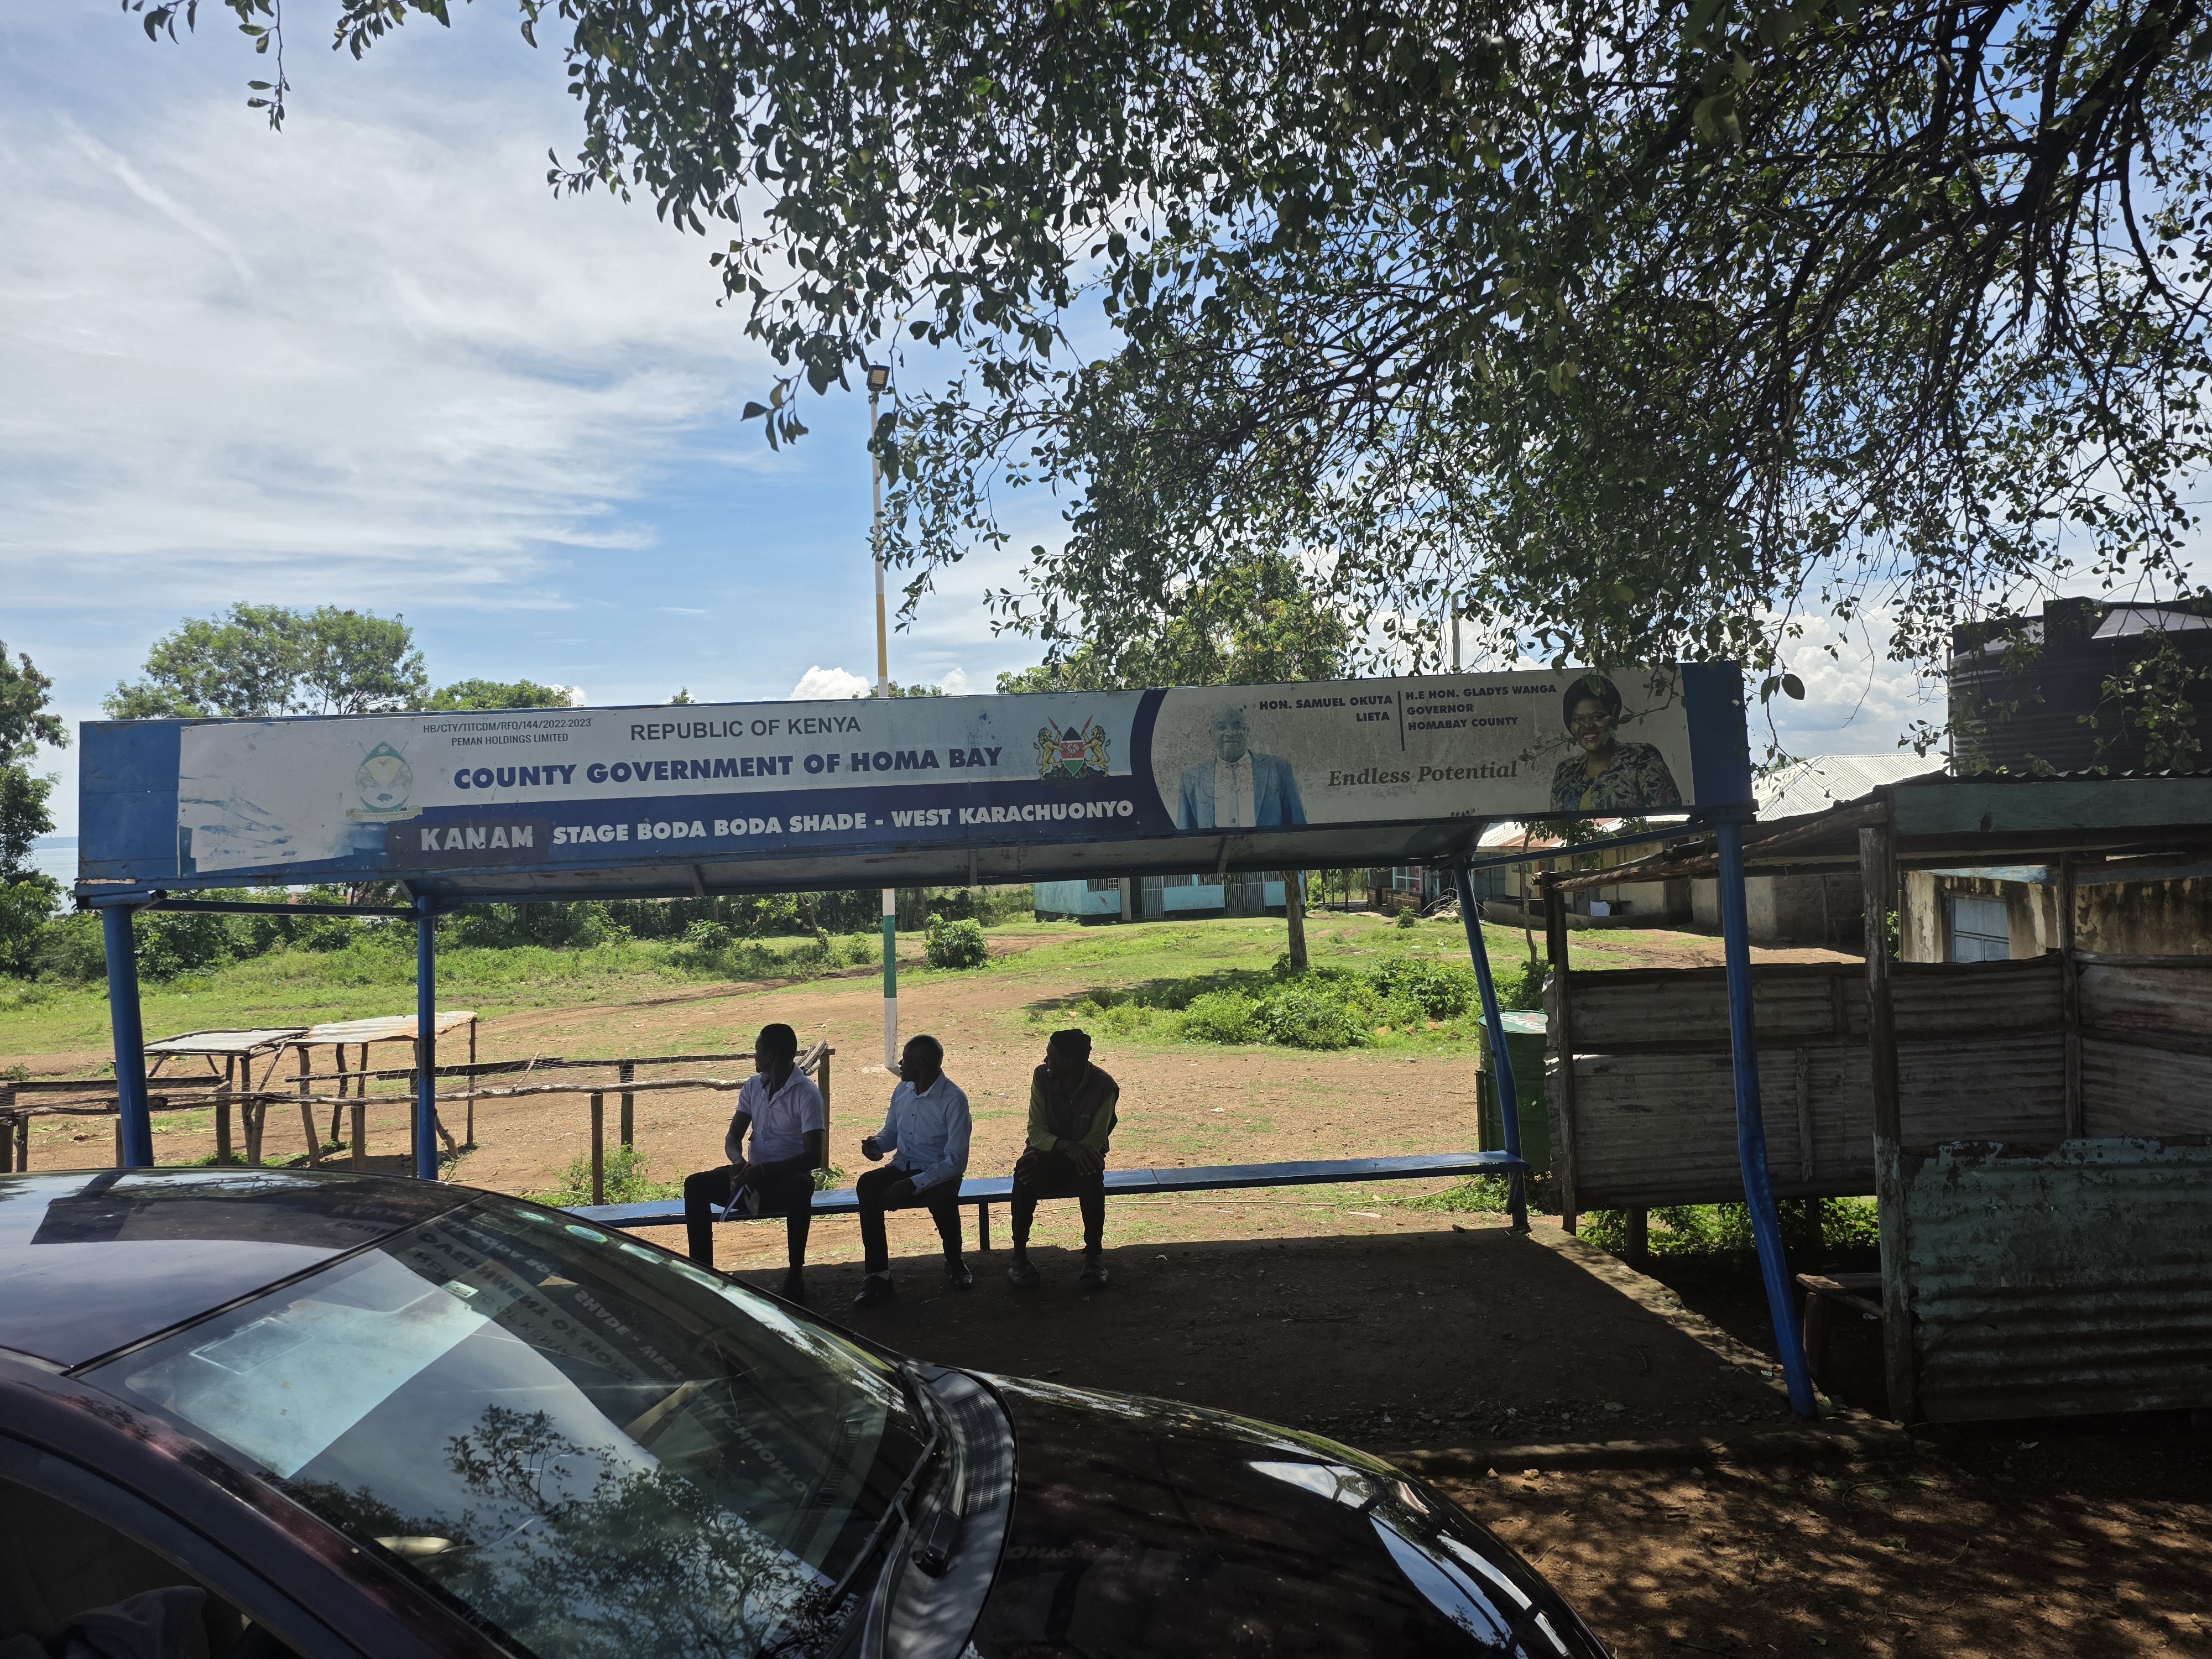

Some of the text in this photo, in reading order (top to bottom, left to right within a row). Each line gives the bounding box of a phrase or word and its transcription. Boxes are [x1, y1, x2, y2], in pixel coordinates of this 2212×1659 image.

[1406, 685, 1557, 700] H.E HON. GLADYS WANGA
[1260, 695, 1392, 710] HON. SAMUEL OKUTA
[1407, 704, 1474, 715] GOVERNOR
[1357, 712, 1390, 722] LIETA
[1408, 717, 1518, 730] HOMABAY COUNTY
[423, 718, 592, 733] HB/CTY/TITCDM/RFQ/144/2022-2023
[631, 717, 861, 740] REPUBLIC OF KENYA
[452, 733, 568, 746] PEMAN HOLDINGS LIMITED
[455, 747, 1003, 789] COUNTY GOVERNMENT OF HOMA BAY
[1328, 760, 1518, 786] Endless Potential
[421, 826, 533, 851] KANAM
[553, 825, 628, 844] STAGE
[638, 821, 707, 839] BODA
[714, 817, 782, 836] BODA
[790, 813, 866, 832] SHADE
[891, 809, 951, 827] WEST
[959, 800, 1133, 824] KARACHUONYO
